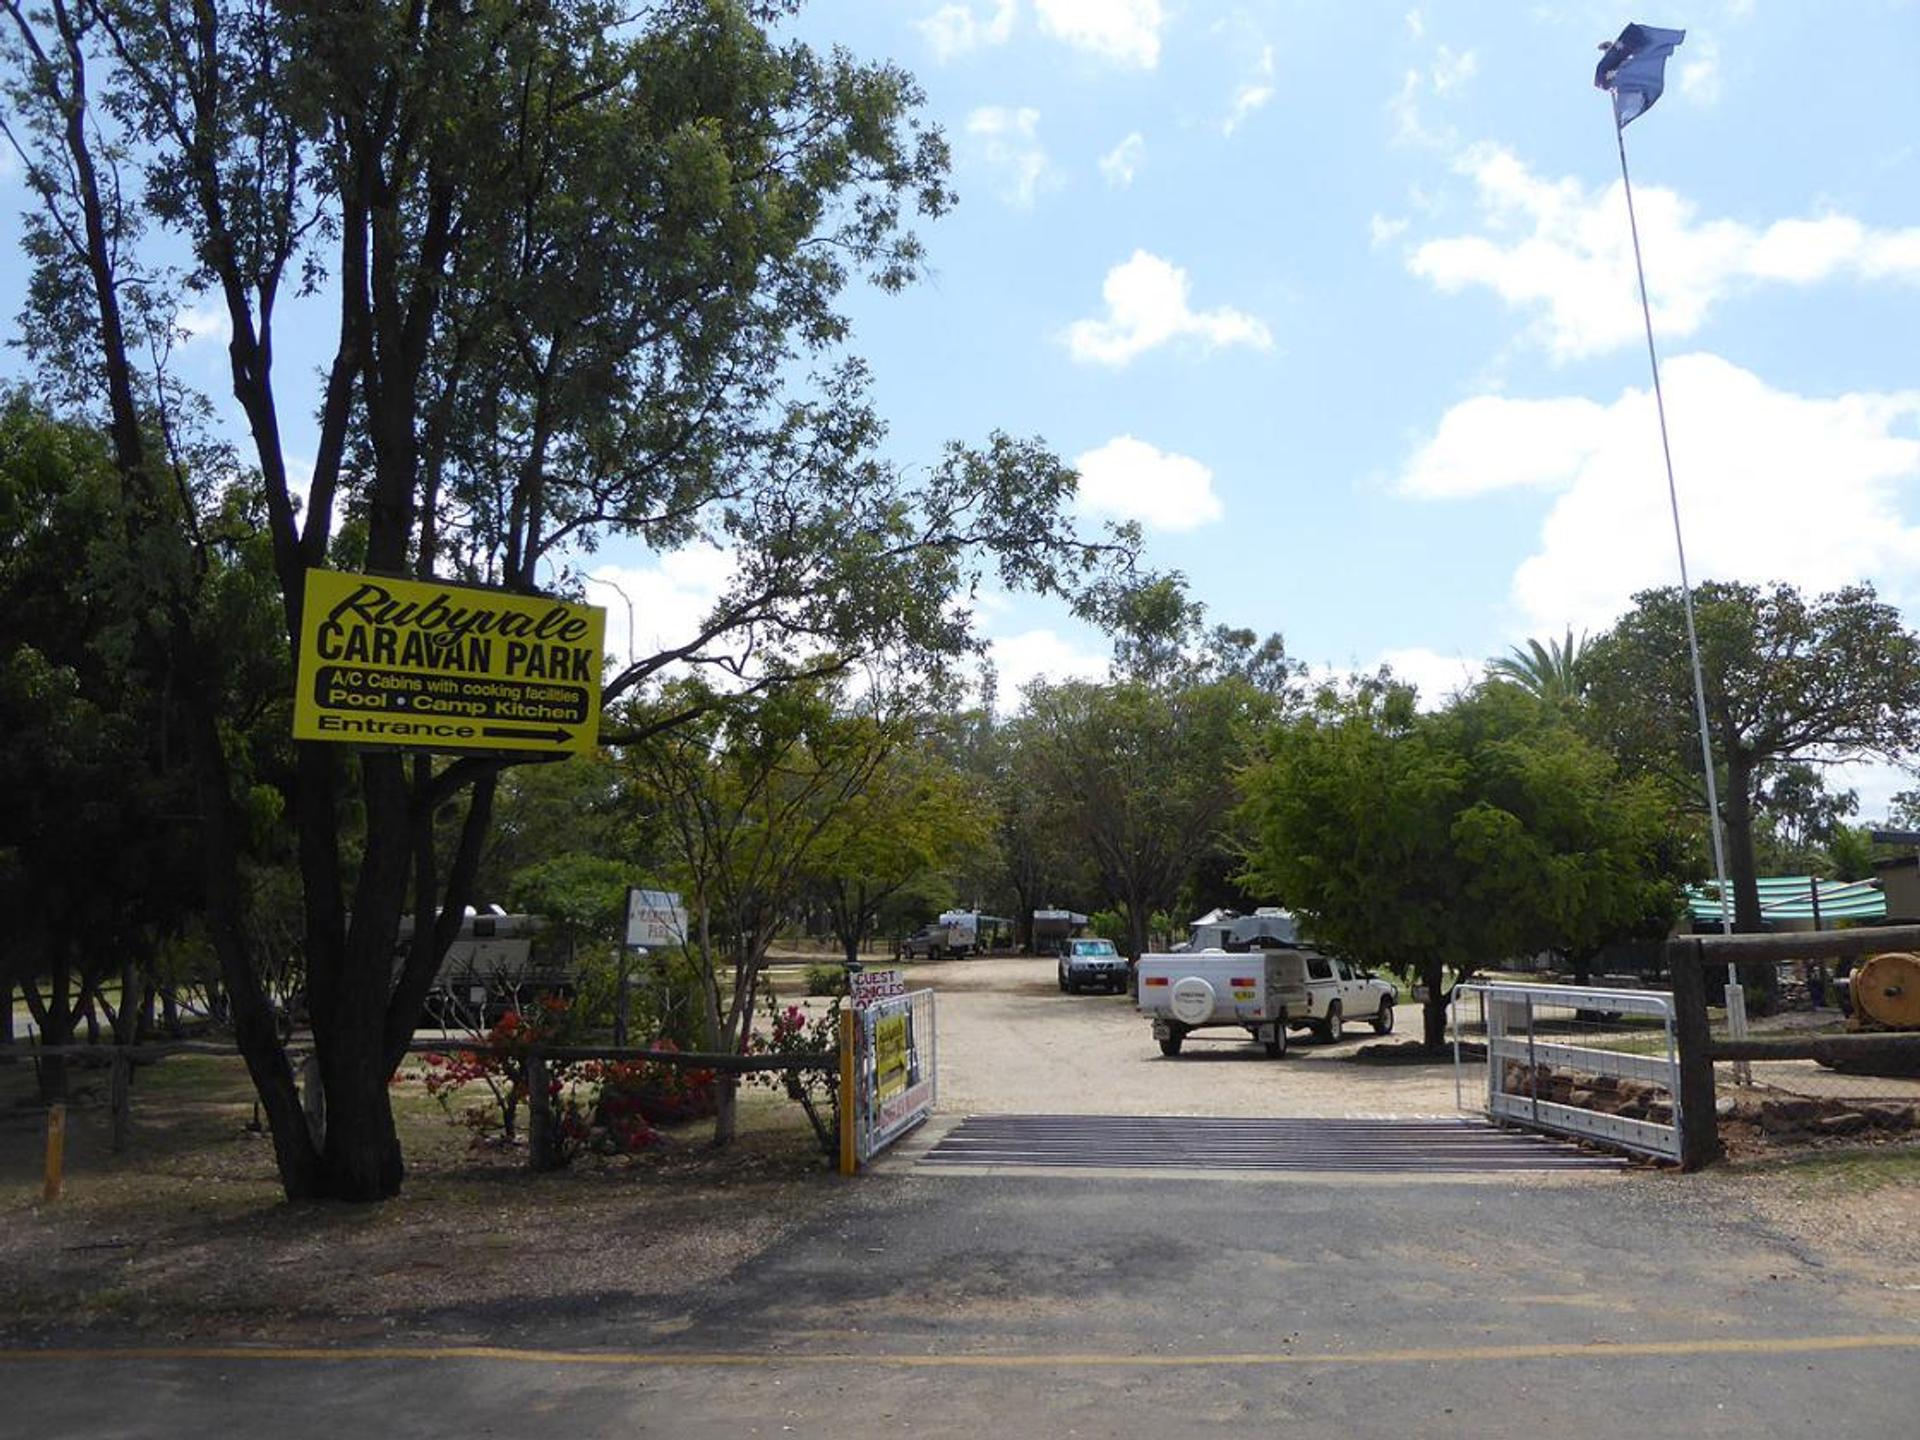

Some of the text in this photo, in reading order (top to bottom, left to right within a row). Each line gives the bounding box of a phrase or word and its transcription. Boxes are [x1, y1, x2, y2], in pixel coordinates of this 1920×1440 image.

[329, 583, 590, 647] Rubyvale
[316, 621, 592, 682] CARAVAN PARK
[331, 670, 580, 703] A/C Cabins with cooking facilities
[329, 689, 578, 719] Pool Camp Kitchen
[319, 715, 475, 737] Entrance
[855, 970, 895, 984] GUEST
